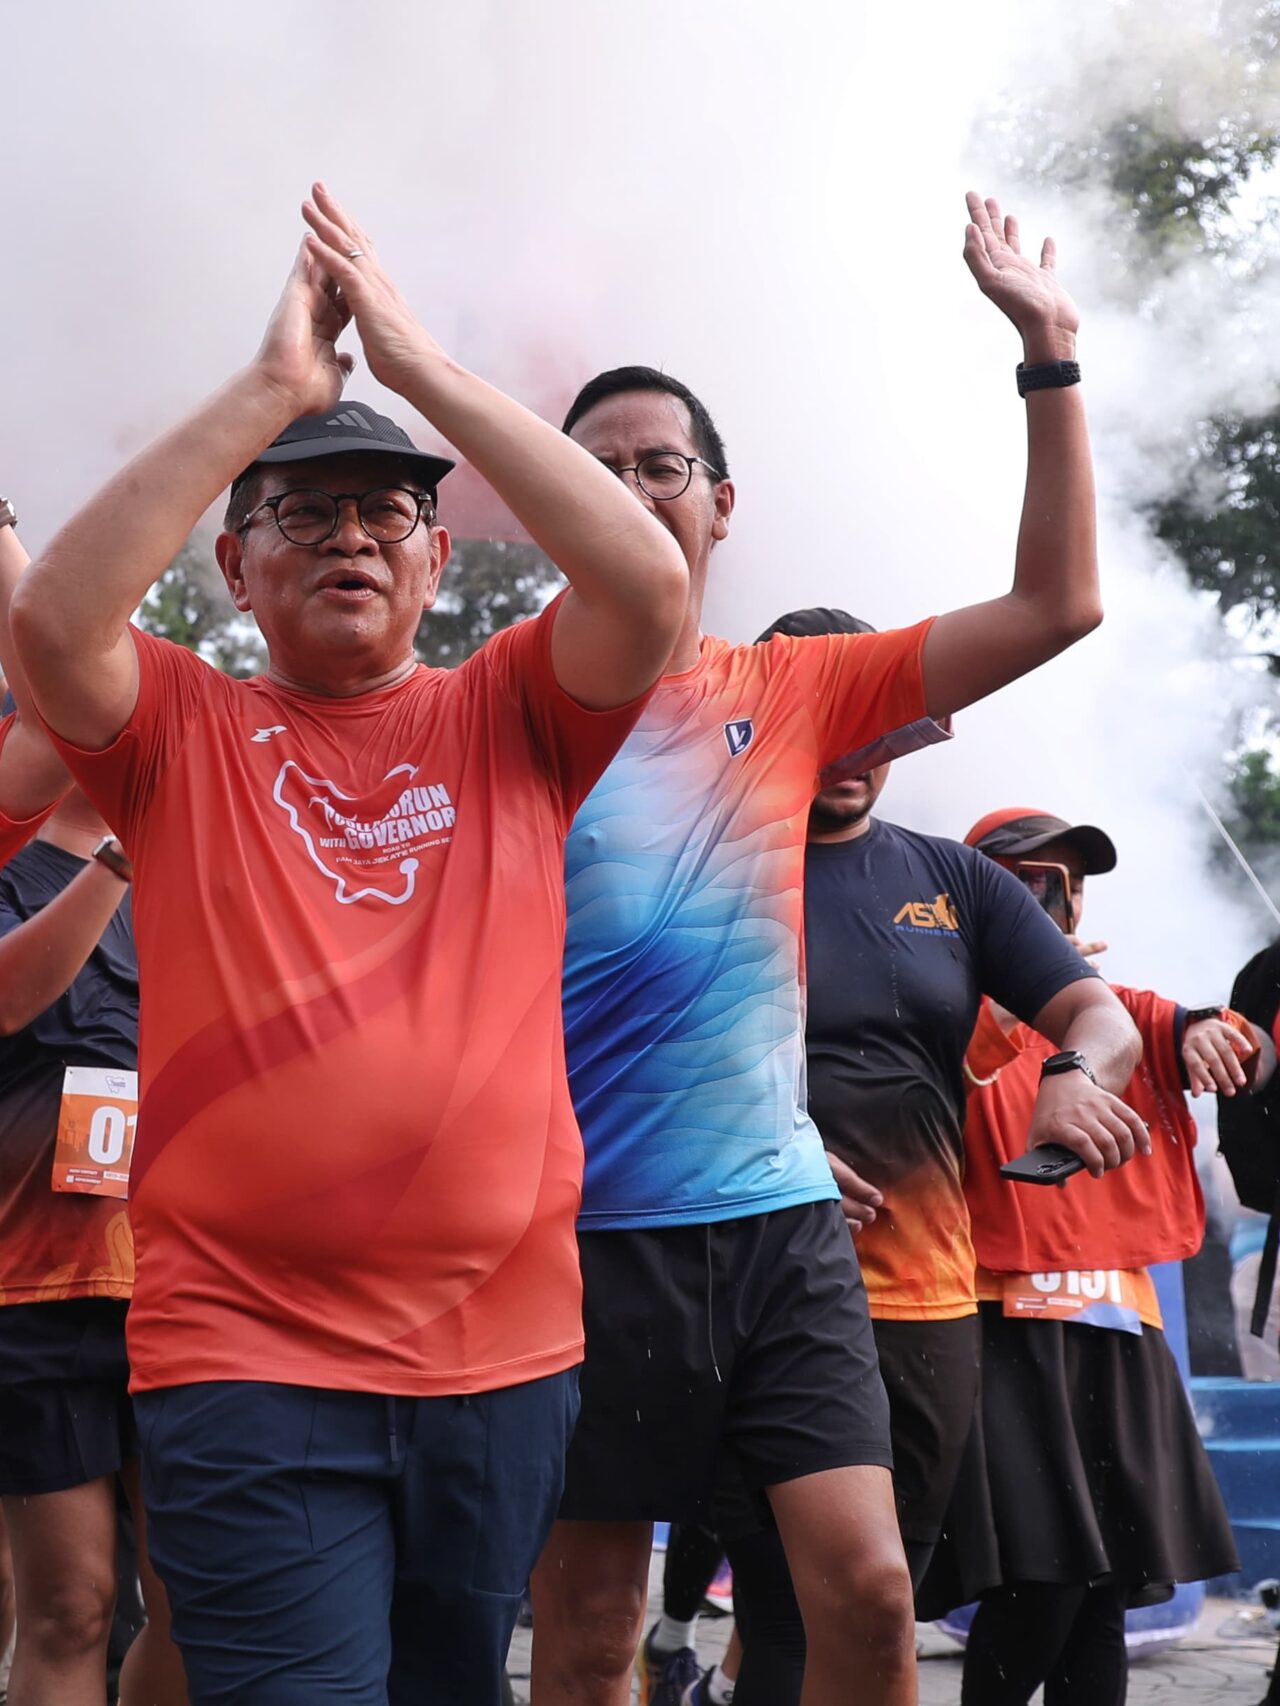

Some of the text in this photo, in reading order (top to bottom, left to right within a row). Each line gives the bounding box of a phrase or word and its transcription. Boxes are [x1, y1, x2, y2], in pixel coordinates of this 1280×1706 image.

[320, 806, 456, 850] WITH GOVERNOR
[334, 783, 452, 833] COLLORUN
[372, 849, 408, 865] JEKATE
